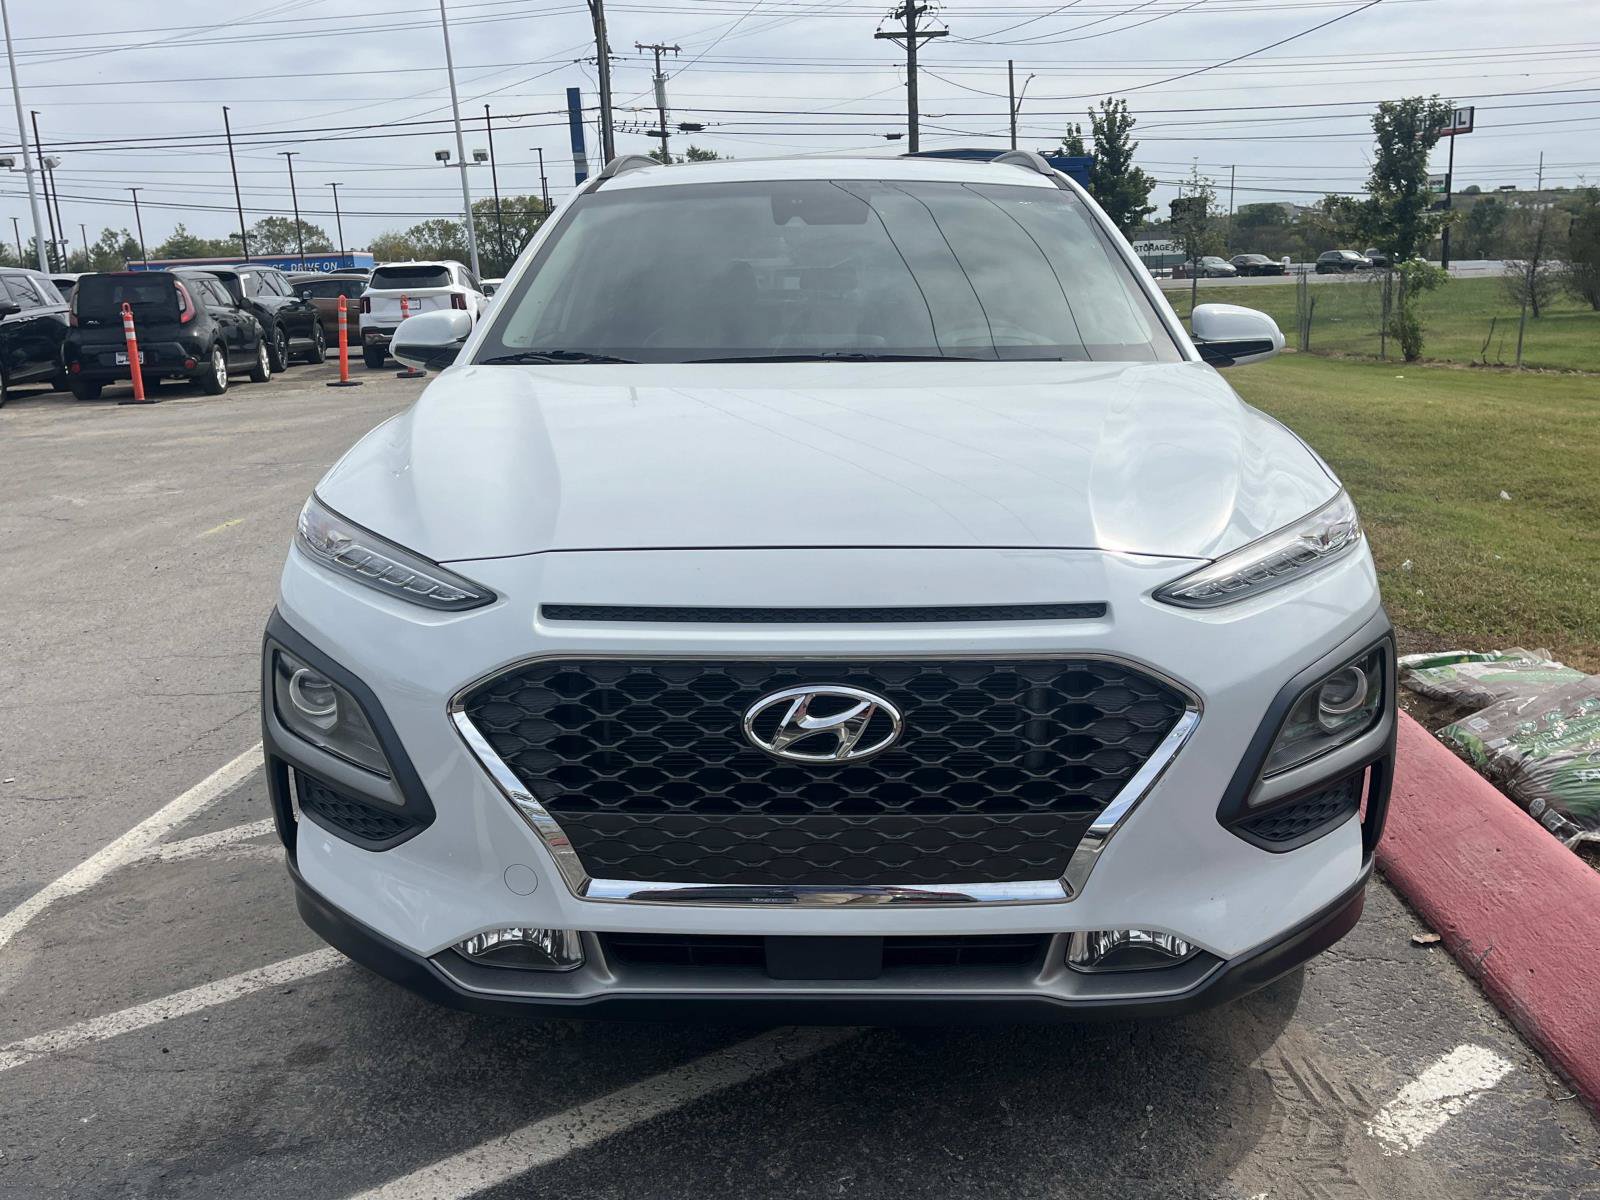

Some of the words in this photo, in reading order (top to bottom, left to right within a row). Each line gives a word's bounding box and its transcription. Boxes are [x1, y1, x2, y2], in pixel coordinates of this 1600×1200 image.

[1133, 243, 1170, 252] STORAGE
[290, 262, 320, 272] DRIVE
[323, 262, 338, 270] ON
